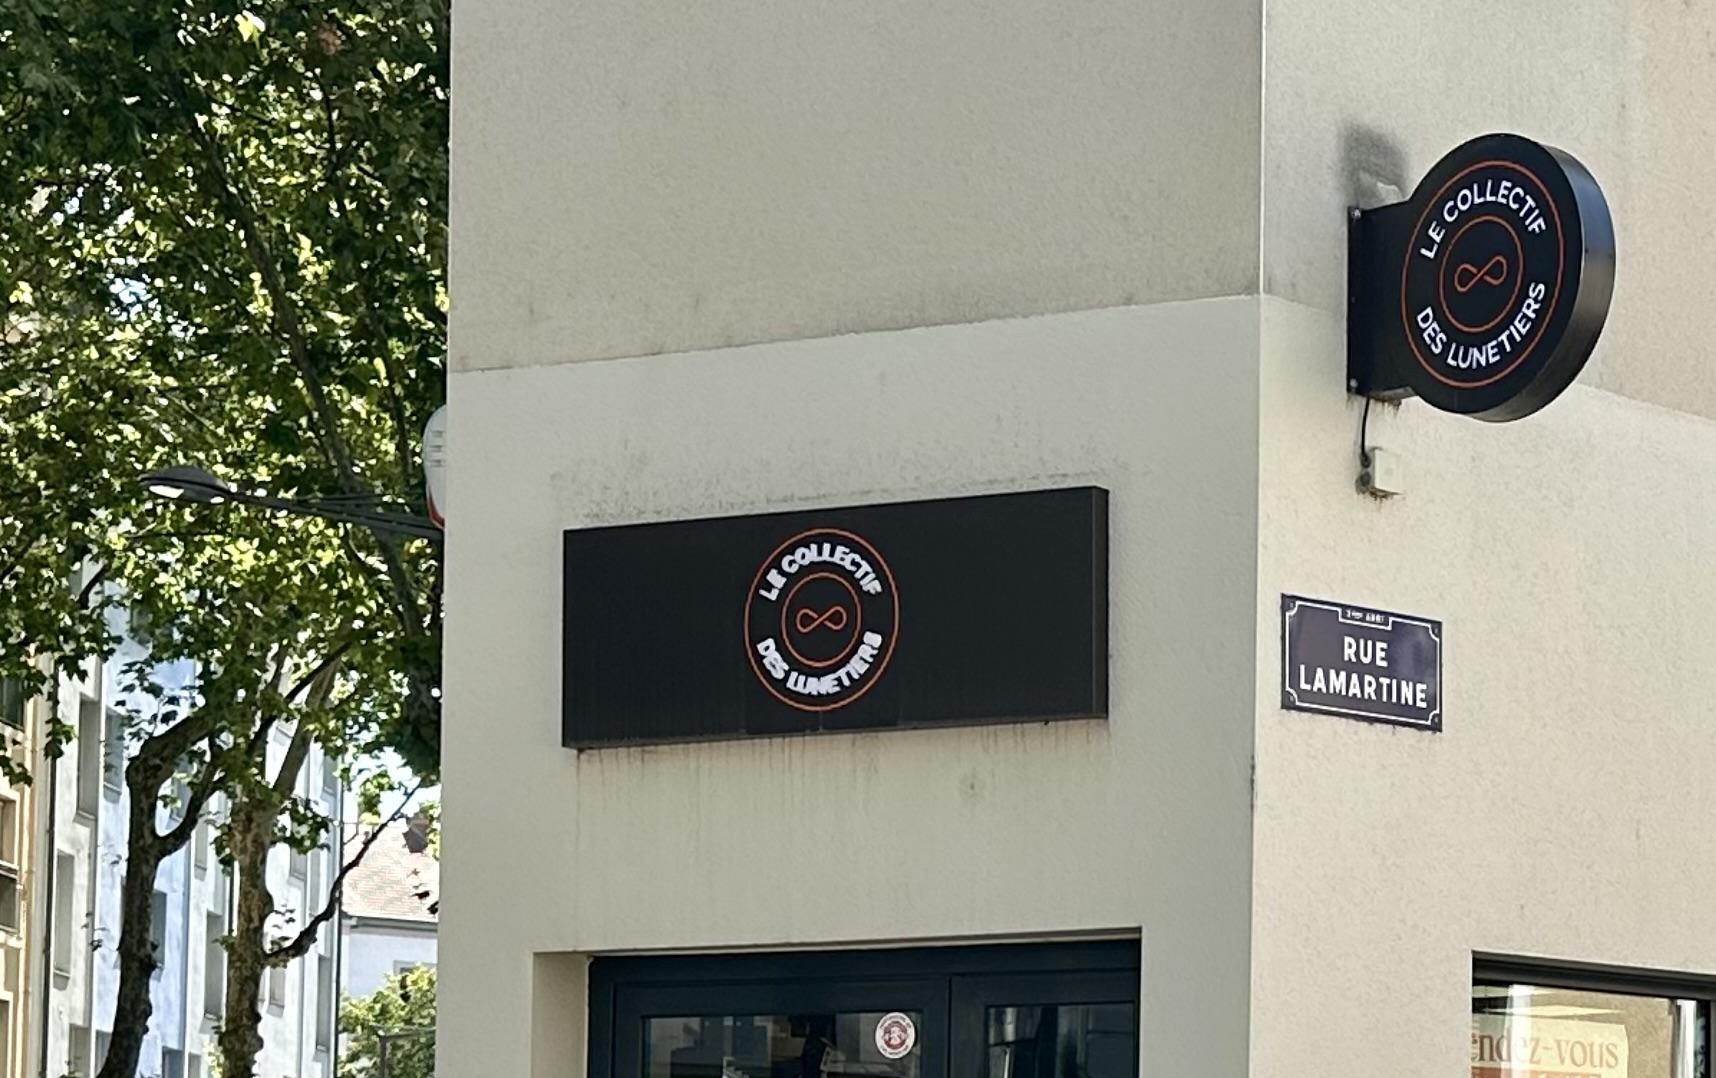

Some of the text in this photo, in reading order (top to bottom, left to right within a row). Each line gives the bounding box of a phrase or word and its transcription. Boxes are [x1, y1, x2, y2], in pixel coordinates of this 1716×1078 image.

[1420, 178, 1547, 259] LE COLLECTIF
[1416, 281, 1546, 369] DES LUNETIERS
[758, 542, 882, 601] LE COLLECTIF
[756, 631, 882, 695] DES LUNETIERS
[1343, 636, 1388, 667] RUE
[1299, 664, 1428, 708] LAMARTINE
